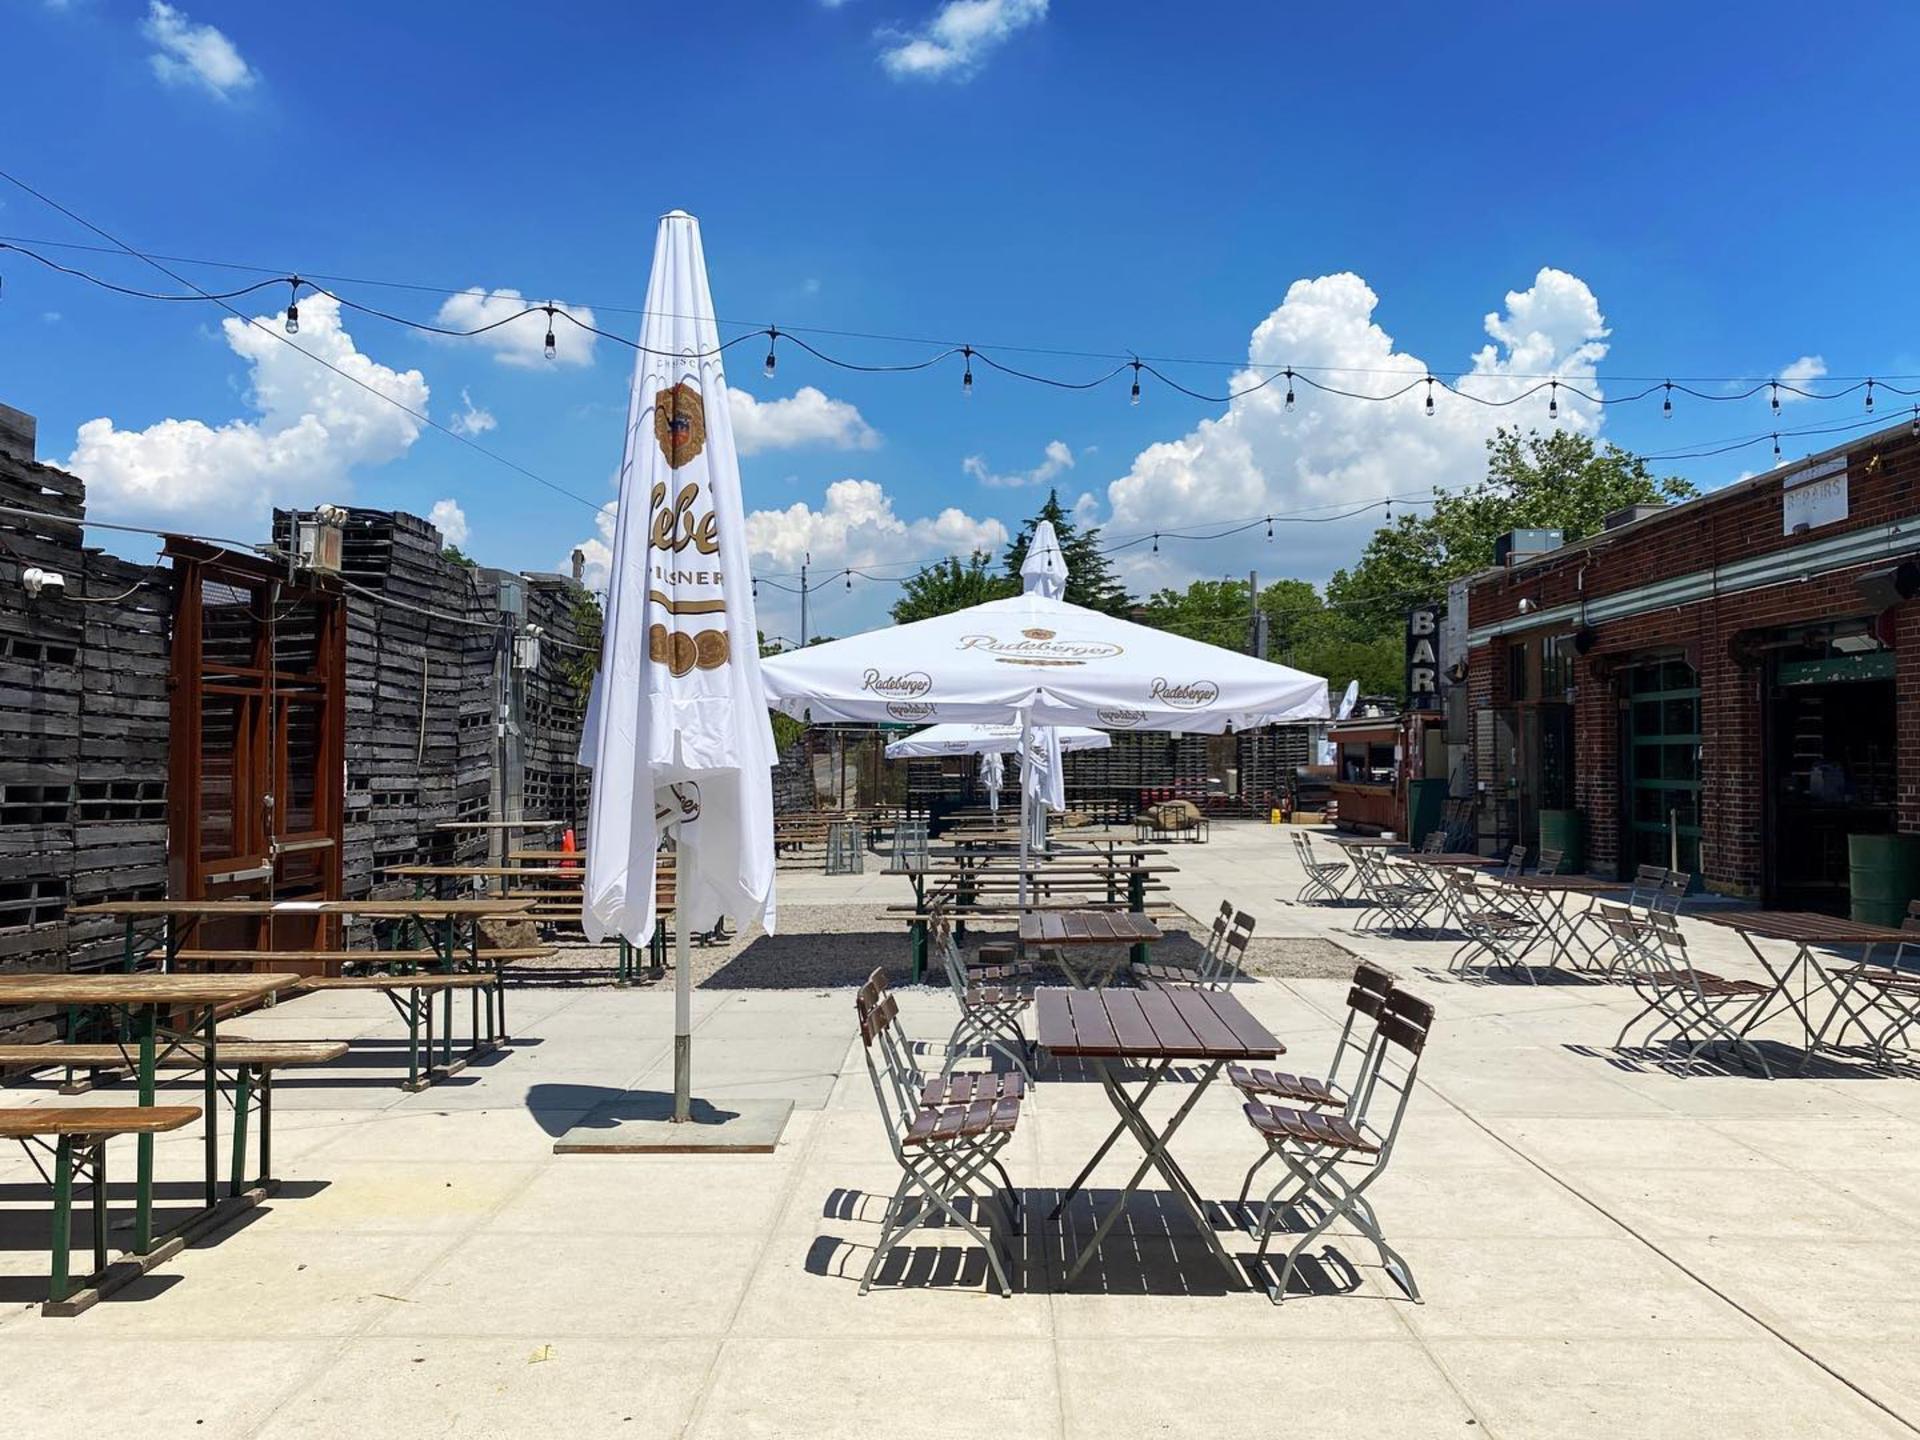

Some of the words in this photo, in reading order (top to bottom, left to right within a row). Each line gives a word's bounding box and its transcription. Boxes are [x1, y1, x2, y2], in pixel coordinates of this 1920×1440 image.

[955, 635, 1124, 658] Radeberger
[1412, 611, 1436, 692] BAR
[862, 668, 932, 699] Radeberger
[1149, 677, 1219, 708] Radeberger
